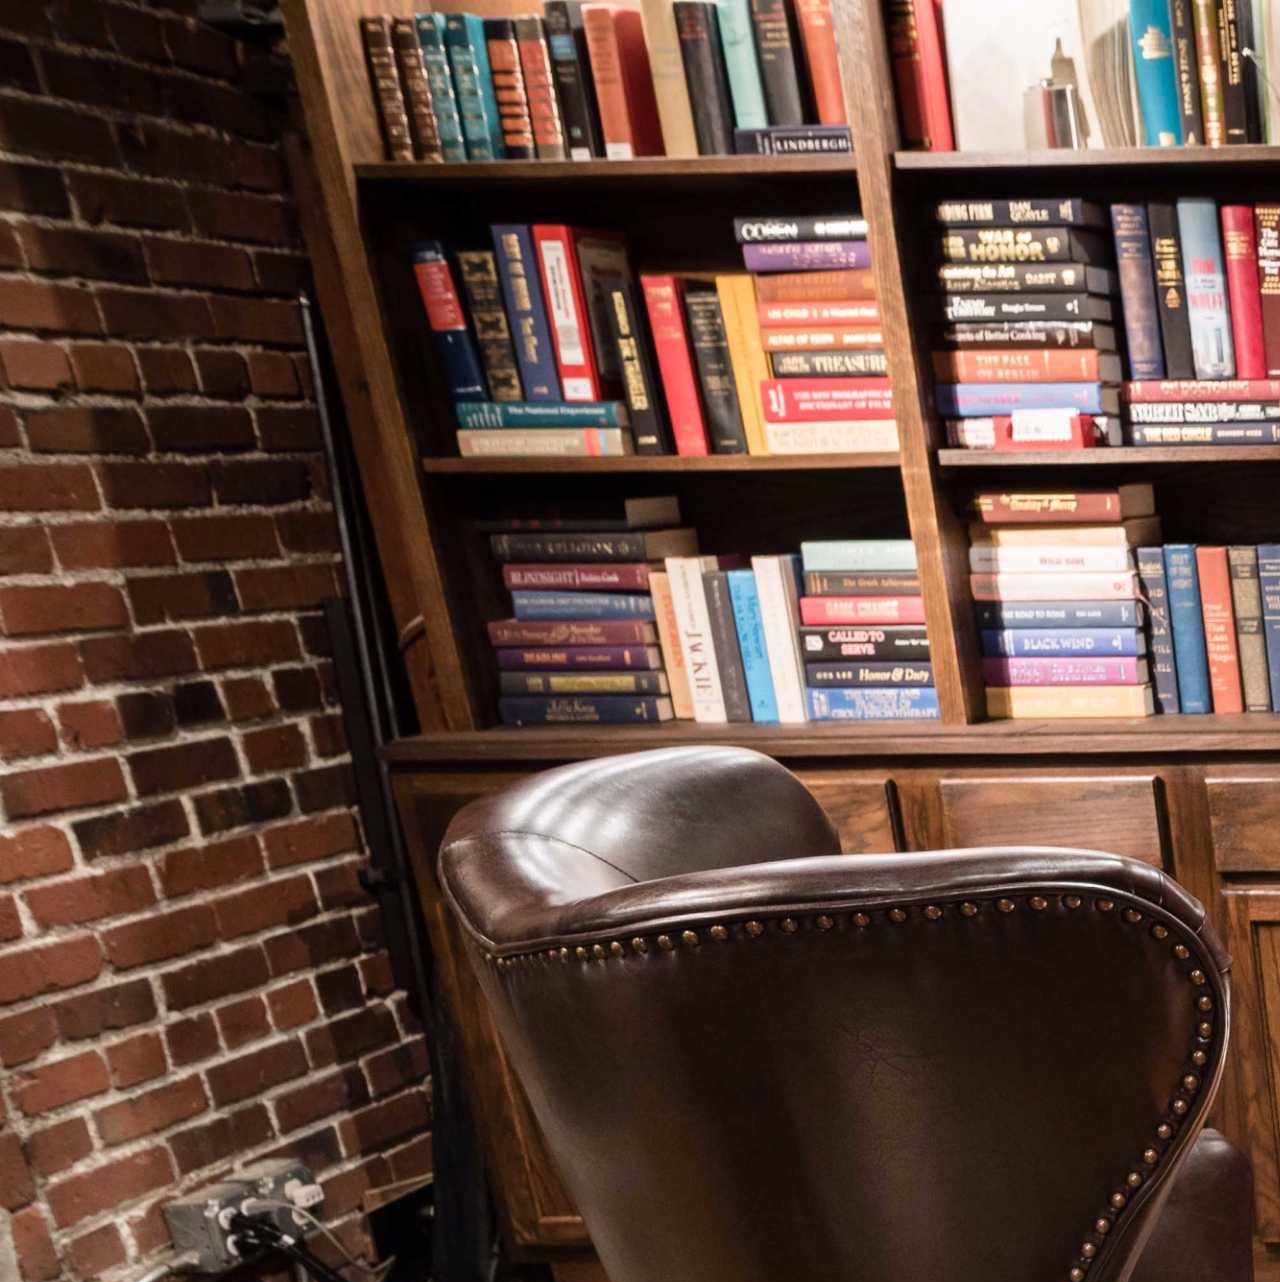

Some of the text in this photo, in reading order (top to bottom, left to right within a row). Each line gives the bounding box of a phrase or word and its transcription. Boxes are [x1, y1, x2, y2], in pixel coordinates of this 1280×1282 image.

[776, 137, 848, 151] LINDBERGH
[1009, 201, 1031, 211] DAN
[1011, 208, 1048, 222] QUAYLE
[742, 221, 798, 240] COBEN
[978, 230, 1014, 243] WAR
[970, 242, 1045, 261] HONOR
[1010, 330, 1046, 342] Cooking
[1187, 381, 1250, 393] DOCTORING
[507, 406, 523, 415] The
[525, 406, 558, 415] National
[511, 571, 575, 585] BLINDSIGHT
[843, 579, 856, 587] The
[828, 631, 885, 643] CALLED TO
[841, 643, 876, 655] SERVE
[1024, 637, 1095, 650] BLACK WIND
[859, 669, 890, 682] Honor
[891, 667, 904, 682] &
[905, 668, 929, 683] Duty
[865, 709, 937, 718] PSYCHOTHERAPY
